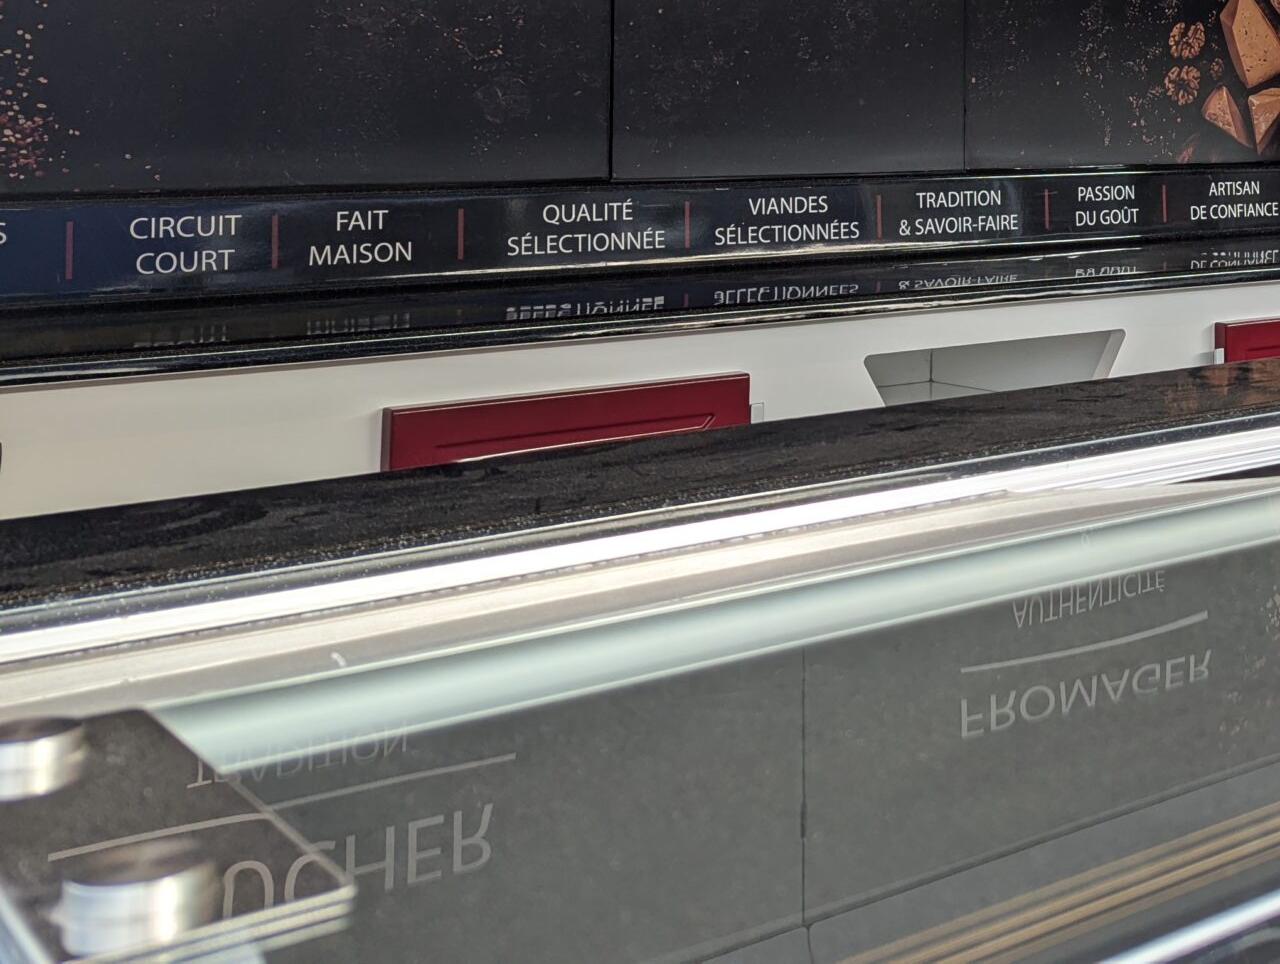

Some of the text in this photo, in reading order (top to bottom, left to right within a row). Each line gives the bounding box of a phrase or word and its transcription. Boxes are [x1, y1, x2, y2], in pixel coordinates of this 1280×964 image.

[915, 189, 1002, 209] TRADITION
[1078, 185, 1135, 203] PASSION
[1208, 180, 1260, 198] ARTISAN
[542, 198, 634, 224] QUALITÉ
[748, 195, 829, 216] VIANDES
[1075, 204, 1140, 227] DU GOÛT
[1190, 201, 1279, 221] DE CONFIANCE
[129, 214, 242, 240] CIRCUIT
[336, 209, 389, 232] FAIT
[714, 218, 861, 246] SÉLECTIONNÉES
[898, 213, 1019, 236] & SAVOIR-FAIRE
[507, 226, 666, 256] SÉLECTIONNÉE
[135, 249, 236, 276] COURT
[309, 241, 412, 266] MAISON
